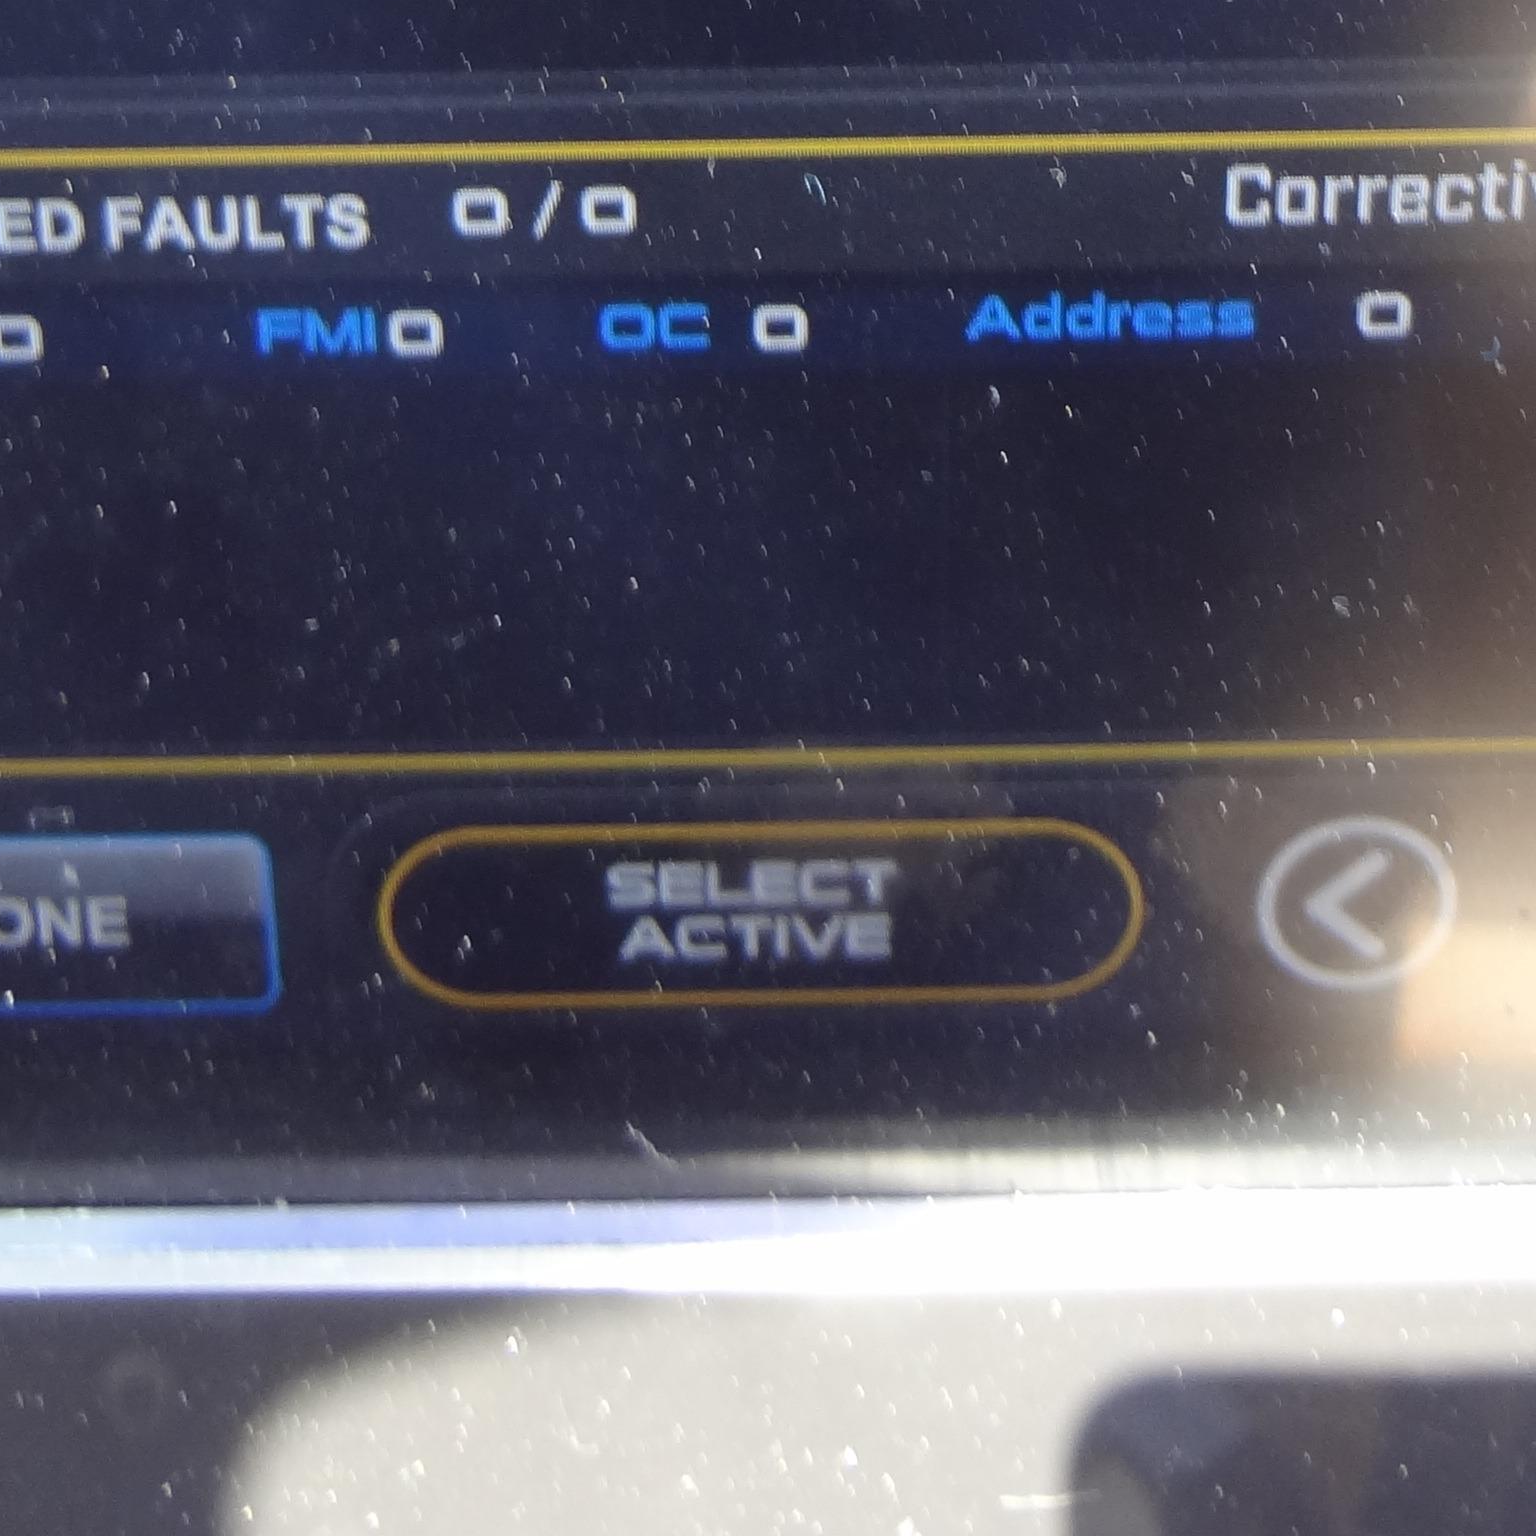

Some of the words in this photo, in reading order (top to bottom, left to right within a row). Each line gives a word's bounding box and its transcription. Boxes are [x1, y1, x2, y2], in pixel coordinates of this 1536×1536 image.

[105, 194, 371, 252] FAULTS
[255, 309, 377, 357] FMI
[598, 304, 710, 352] OC
[964, 288, 1256, 342] Address
[606, 860, 901, 912] SELECT
[618, 909, 895, 962] ACTIVE
